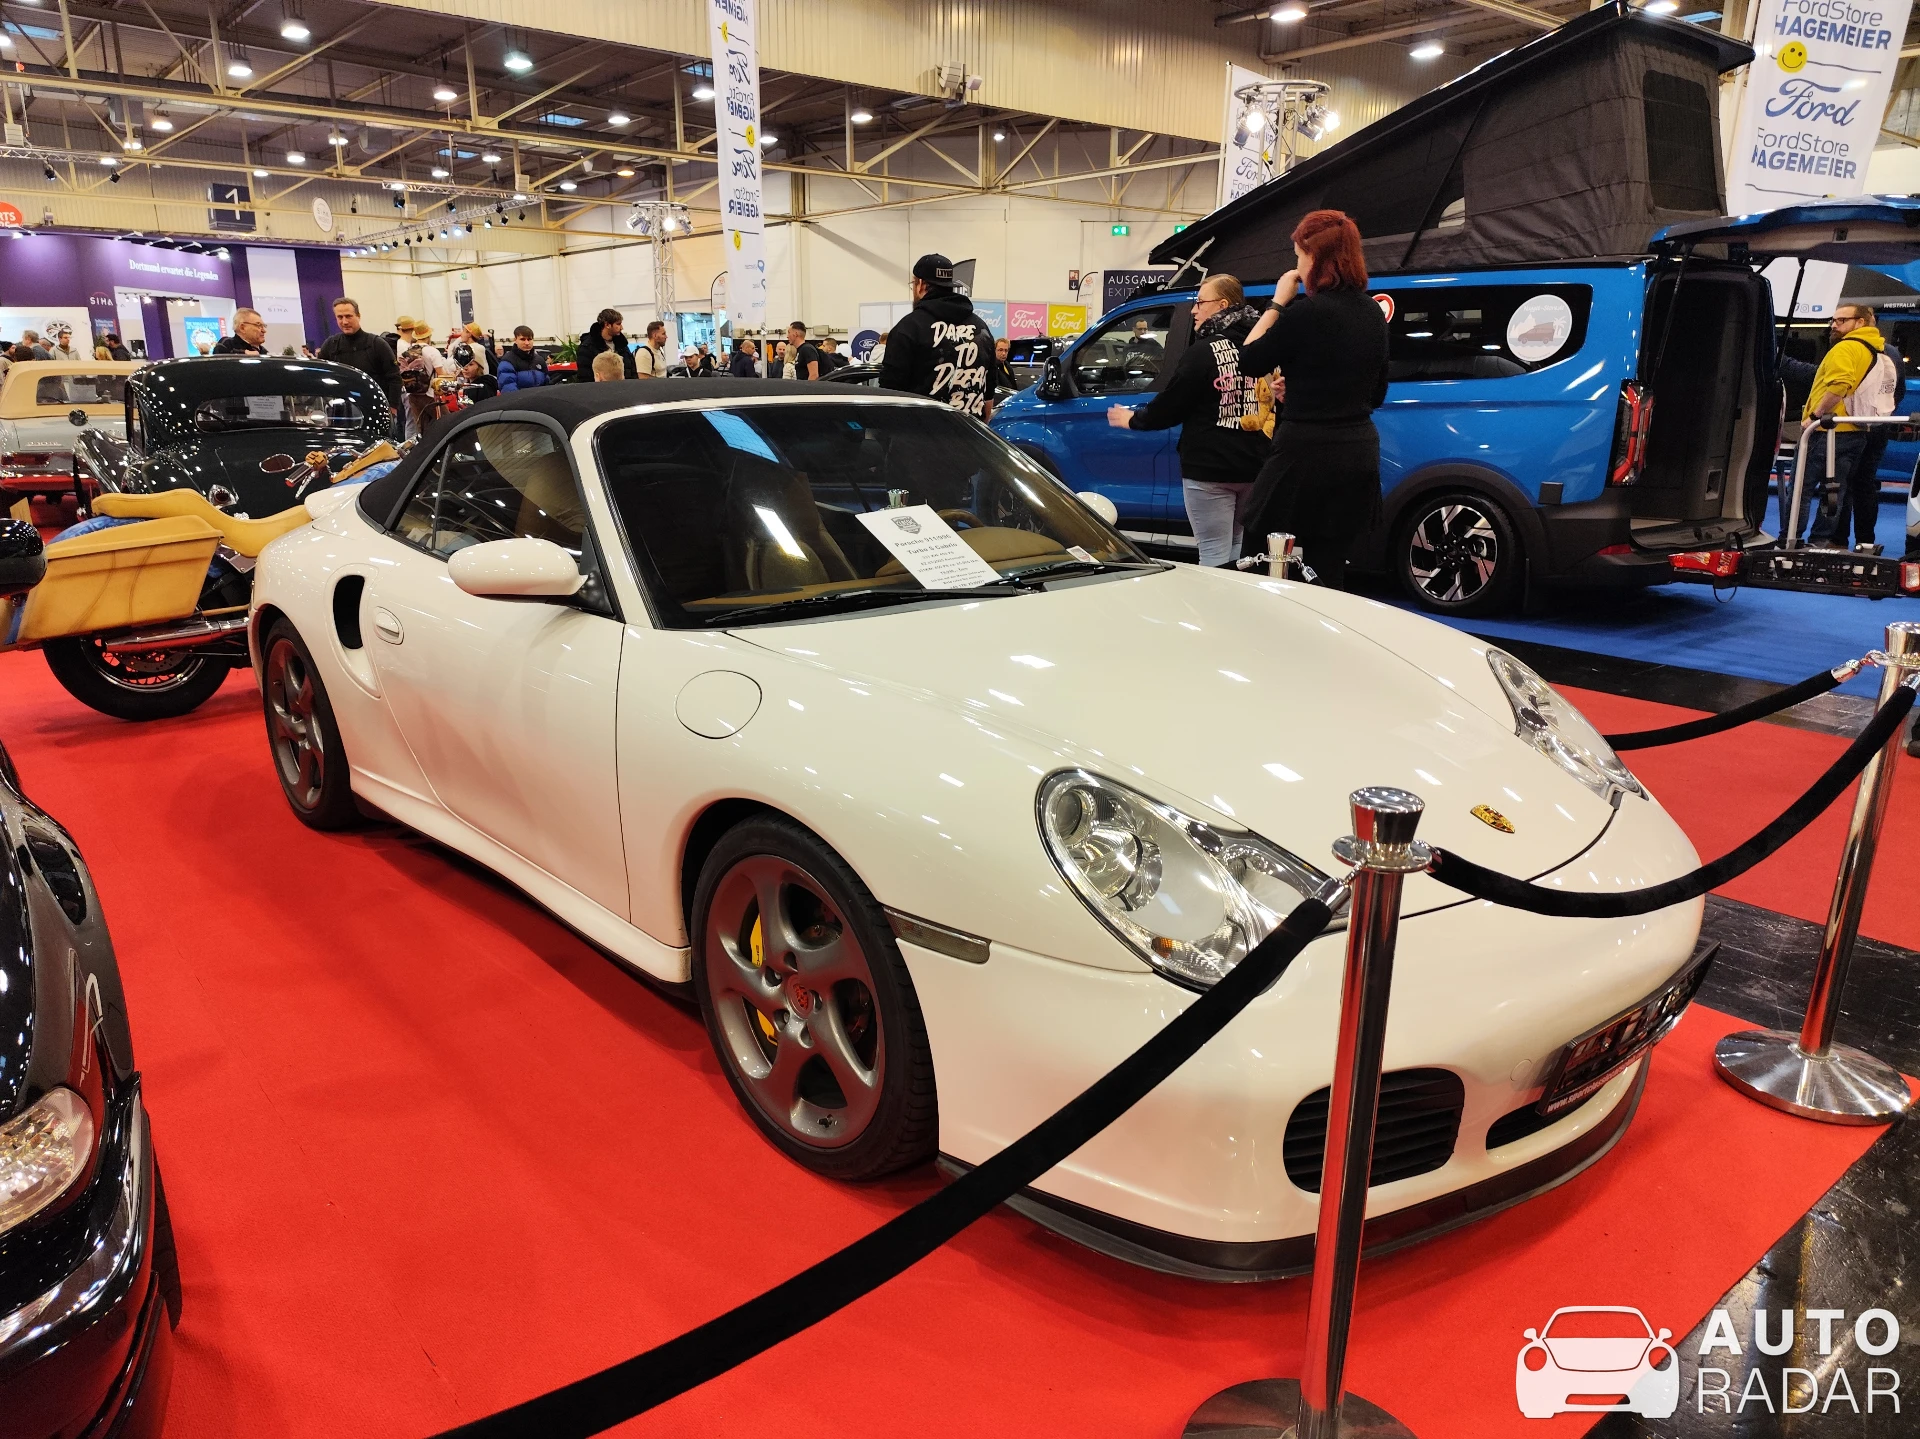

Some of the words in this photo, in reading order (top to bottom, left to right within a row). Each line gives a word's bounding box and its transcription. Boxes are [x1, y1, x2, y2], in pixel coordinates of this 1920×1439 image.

[1774, 15, 1892, 50] HAGEMEIER
[1765, 78, 1861, 126] Ford
[1757, 127, 1849, 157] FordStore
[225, 188, 240, 220] 1
[129, 259, 160, 273] Dortmund
[161, 264, 184, 276] erwartet
[184, 266, 194, 278] die
[194, 268, 219, 281] Legenden
[1108, 275, 1165, 285] AUSGANG
[90, 296, 114, 306] SIHA
[1011, 309, 1043, 329] Ford
[1051, 311, 1081, 330] Ford
[931, 321, 977, 348] DARE
[954, 341, 978, 368] TO
[949, 391, 985, 417] BIG
[906, 547, 928, 555] Turbo
[935, 542, 958, 550] Cabrio
